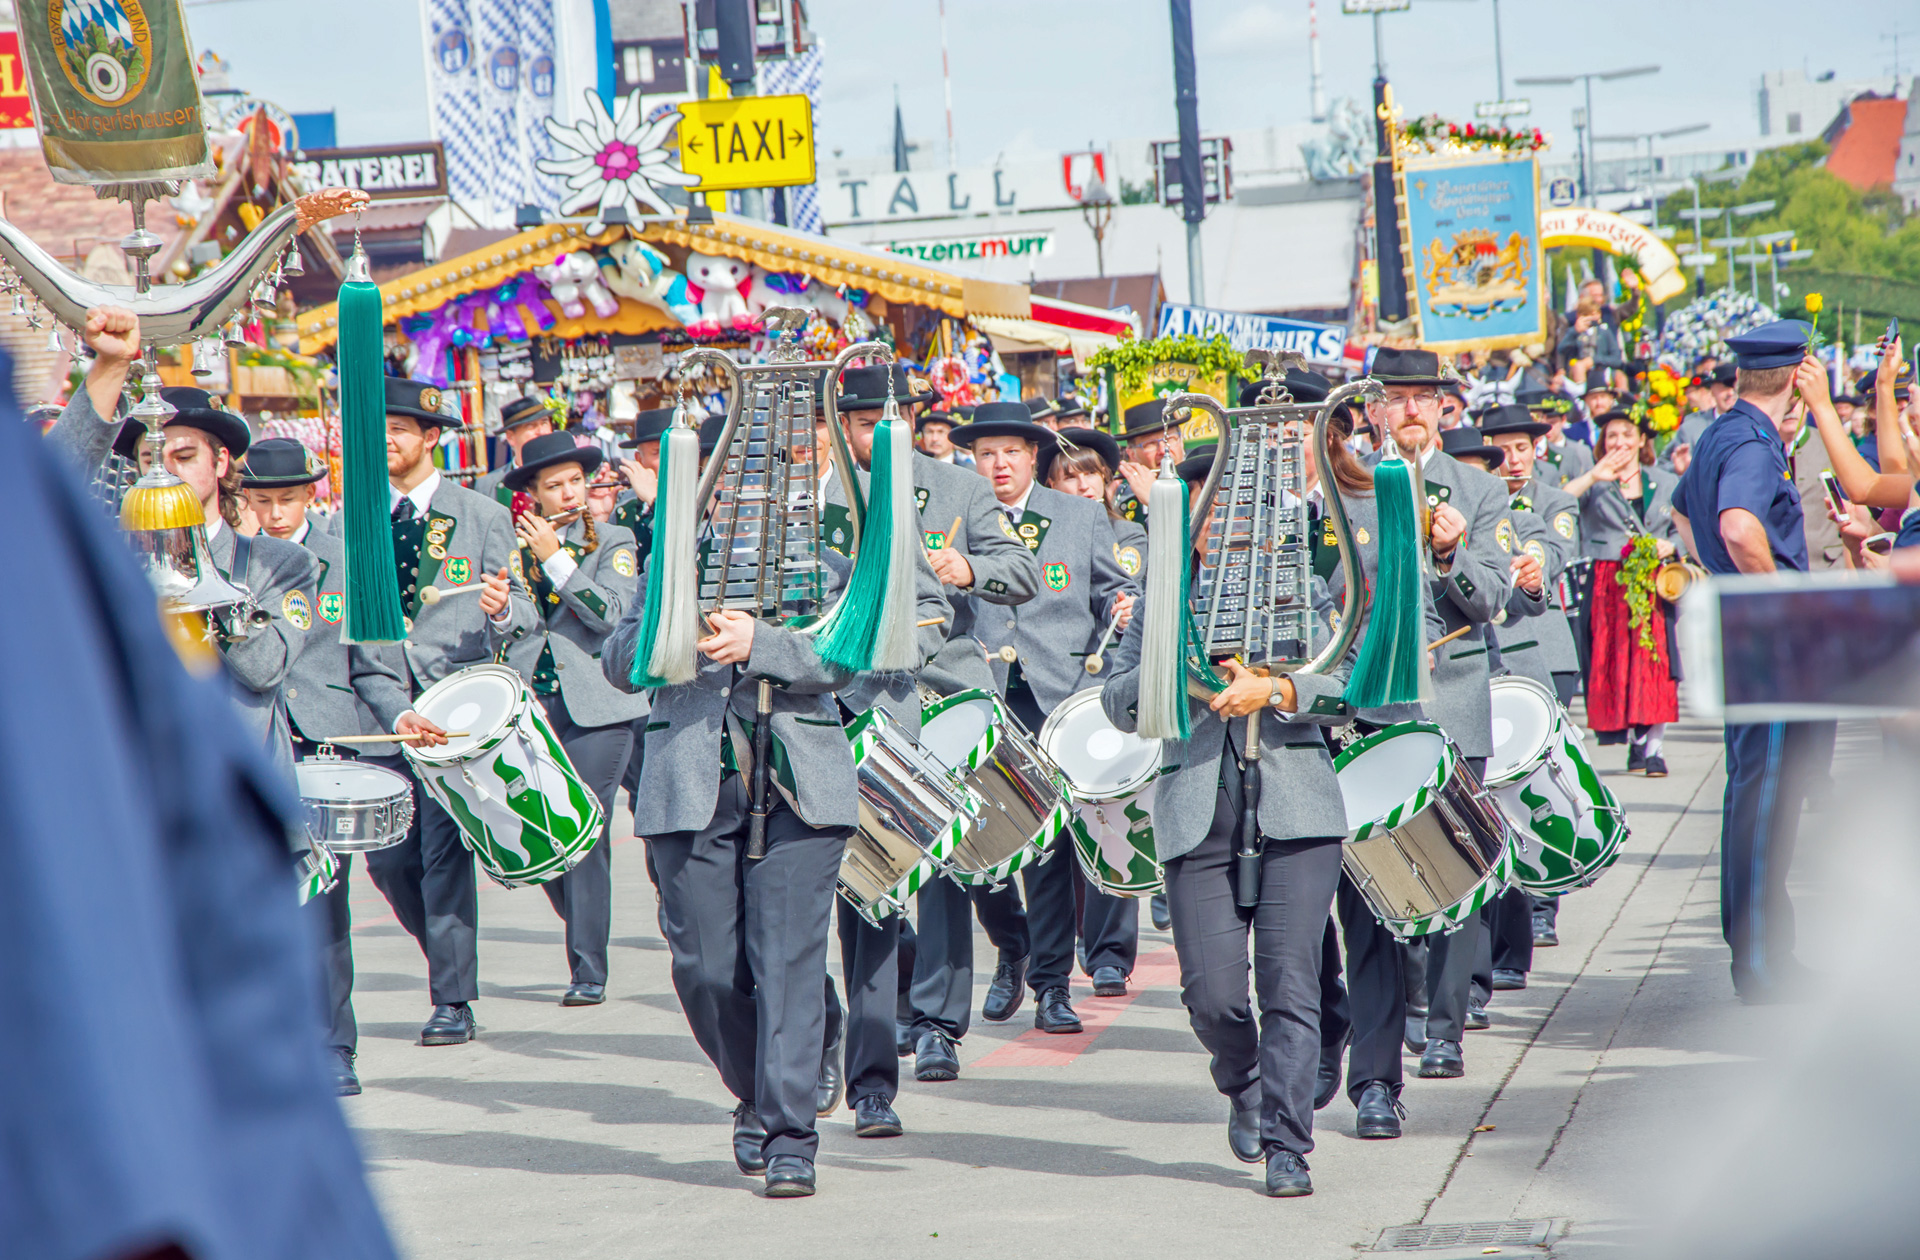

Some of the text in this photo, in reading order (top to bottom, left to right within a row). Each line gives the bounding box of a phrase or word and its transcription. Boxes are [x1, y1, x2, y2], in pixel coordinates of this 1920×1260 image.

[64, 105, 197, 136] Hörgertshausen
[705, 118, 786, 164] TAXI
[886, 236, 1048, 261] inzenzmurr
